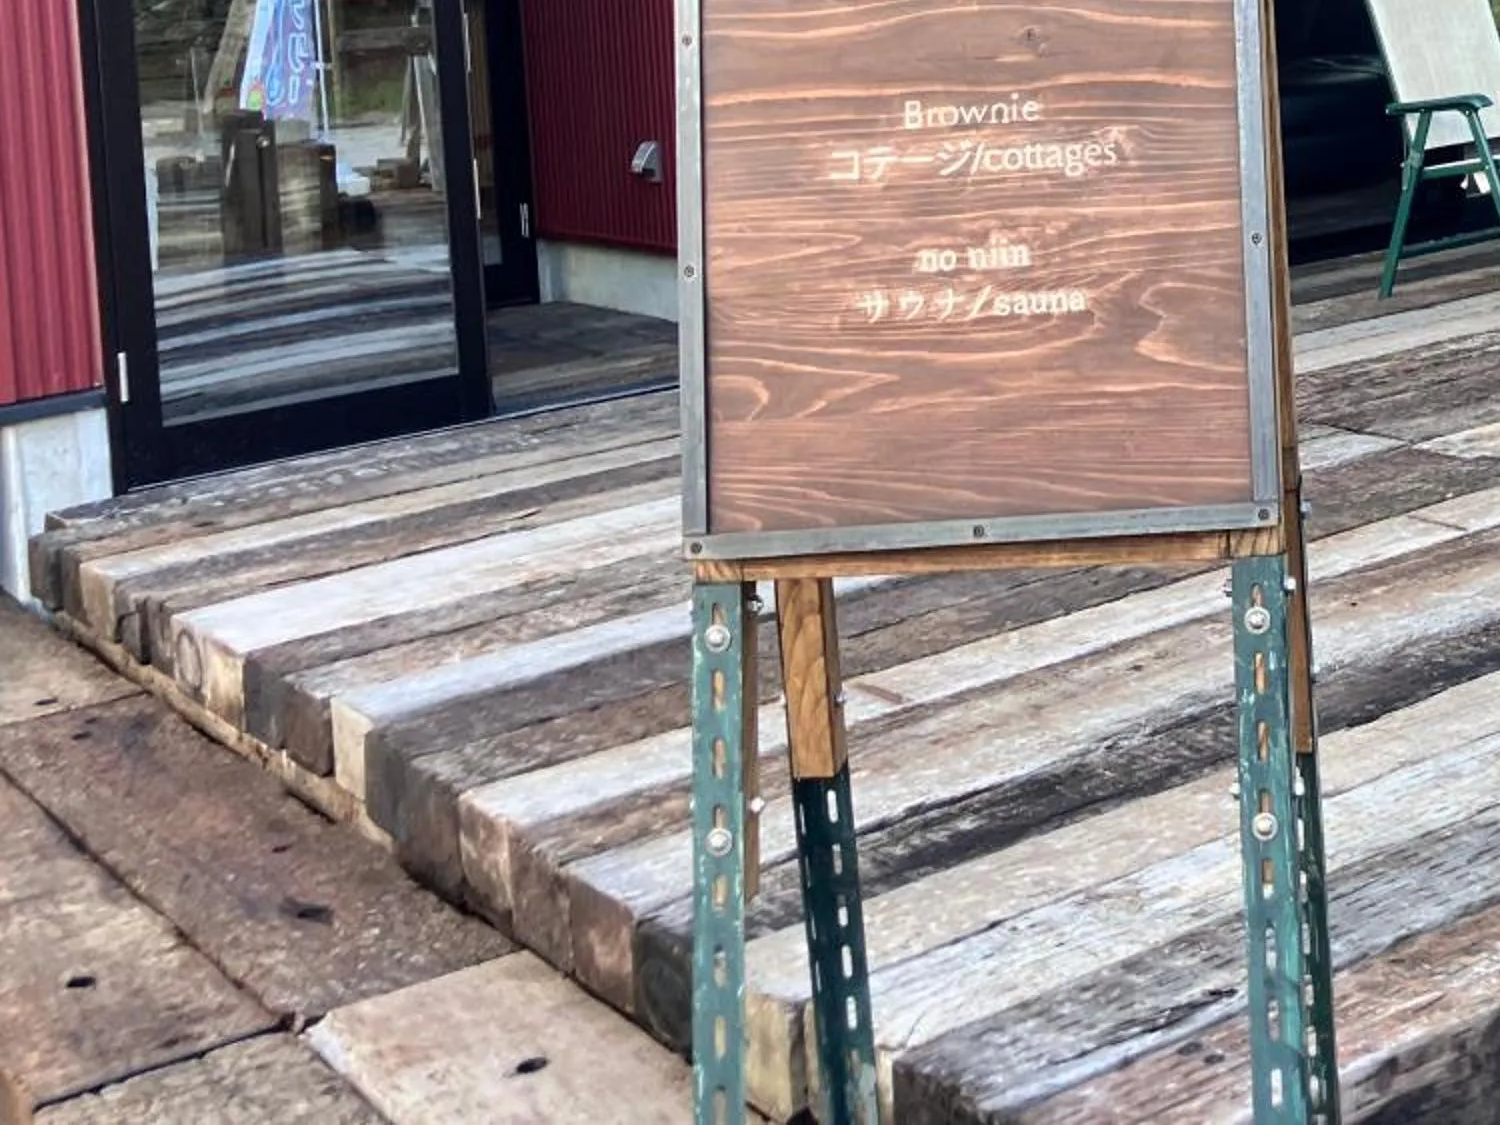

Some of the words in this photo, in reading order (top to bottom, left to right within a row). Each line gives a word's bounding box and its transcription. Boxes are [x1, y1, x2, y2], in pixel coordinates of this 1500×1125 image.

[903, 92, 1042, 129] Brownie
[829, 137, 1119, 181] コテージ/cottages
[917, 247, 958, 273] no
[967, 236, 1033, 269] niin
[855, 285, 1088, 324] サウナ/sauna
